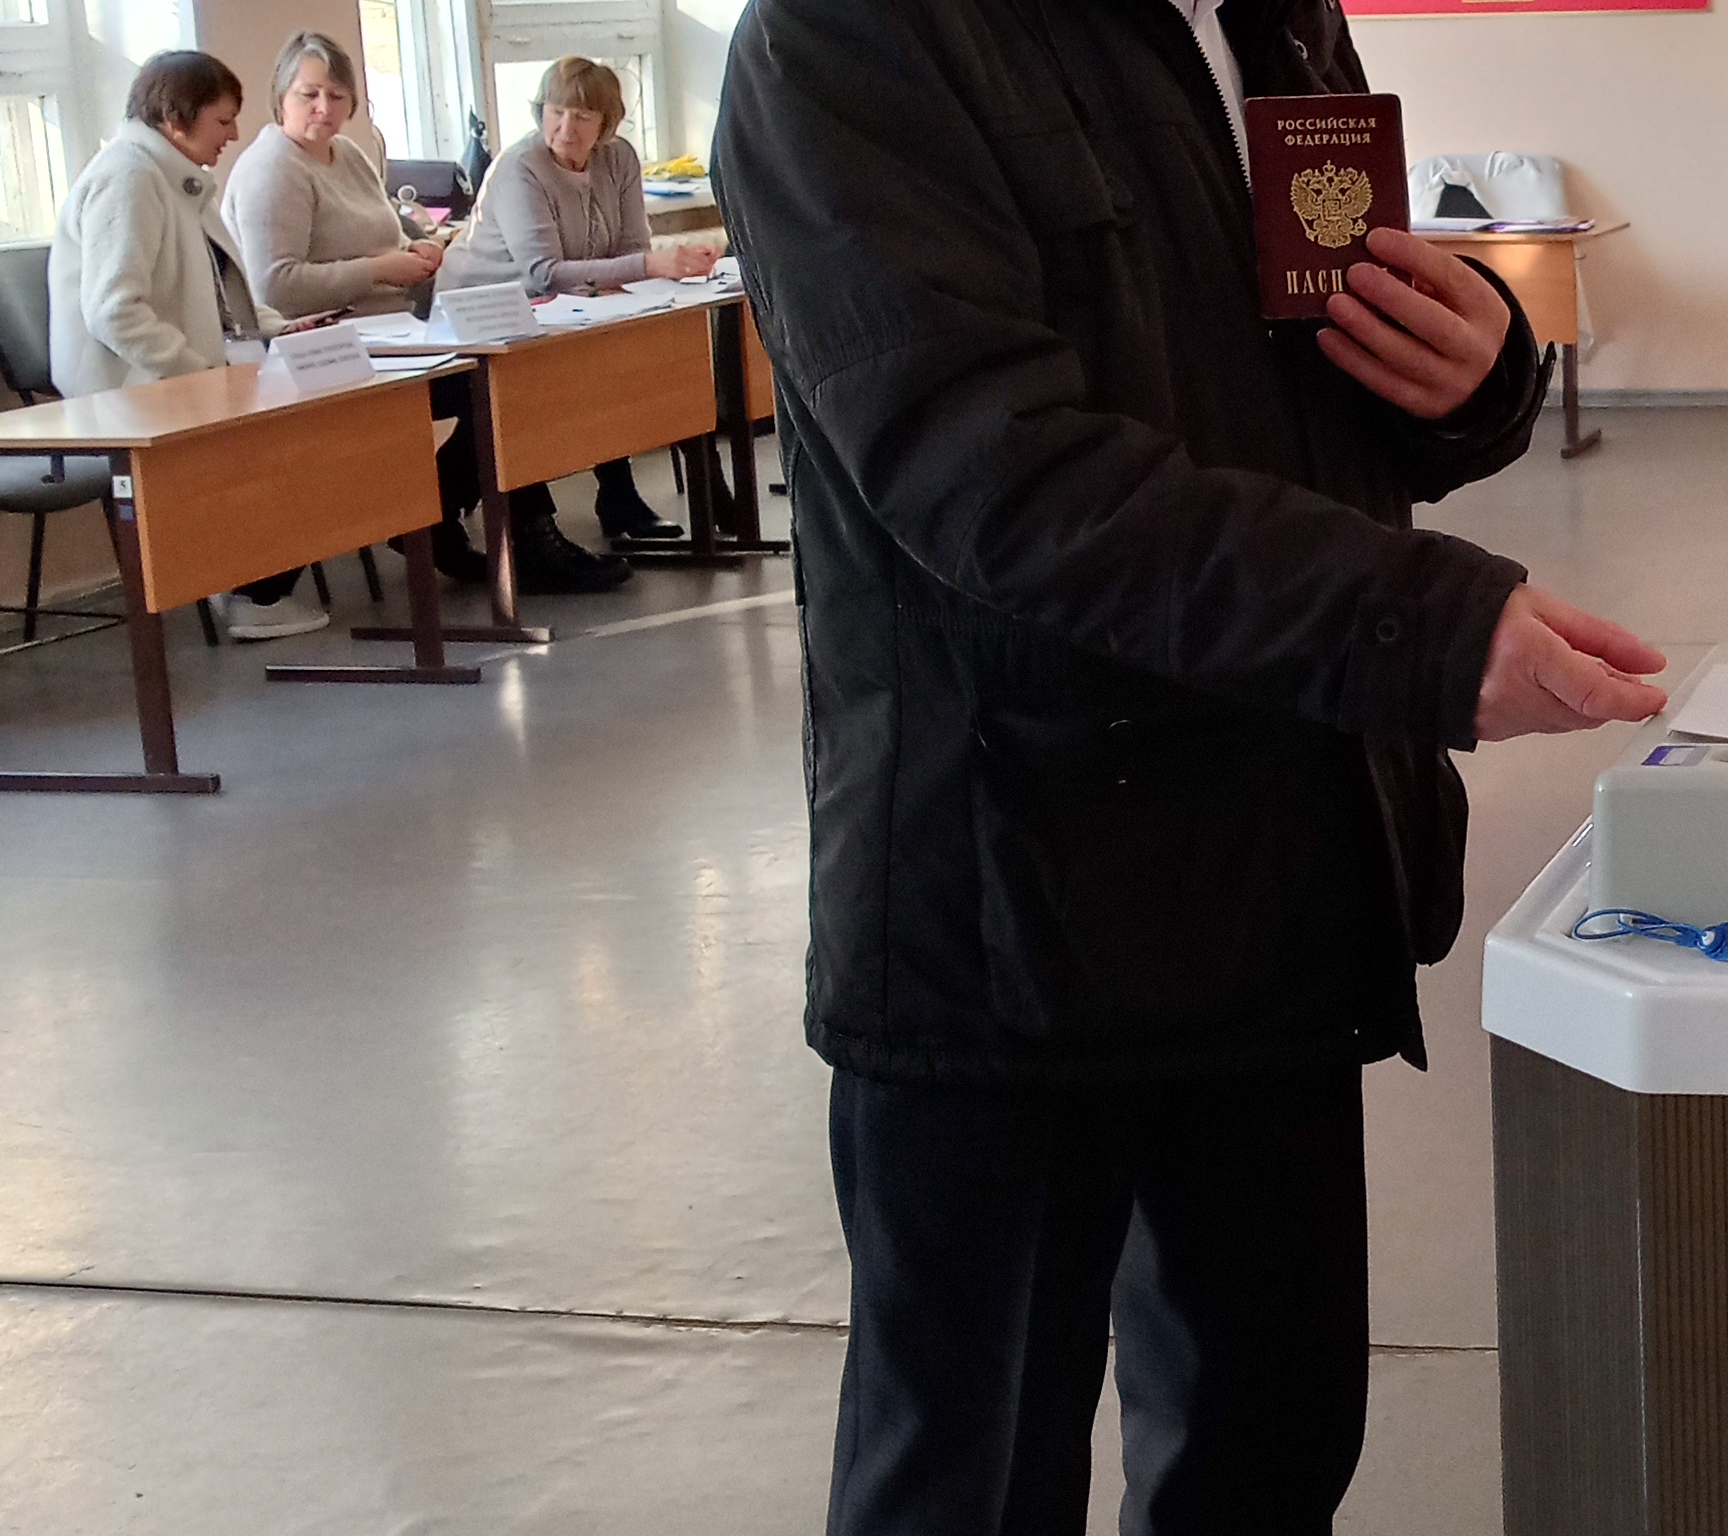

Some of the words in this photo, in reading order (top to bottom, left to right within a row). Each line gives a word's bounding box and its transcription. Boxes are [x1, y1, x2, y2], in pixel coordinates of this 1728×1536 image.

[1277, 116, 1376, 131] РОССИЙСКАЯ
[1284, 132, 1371, 146] ФЕДЕРАЦИЯ
[1286, 269, 1347, 295] ПАСП
